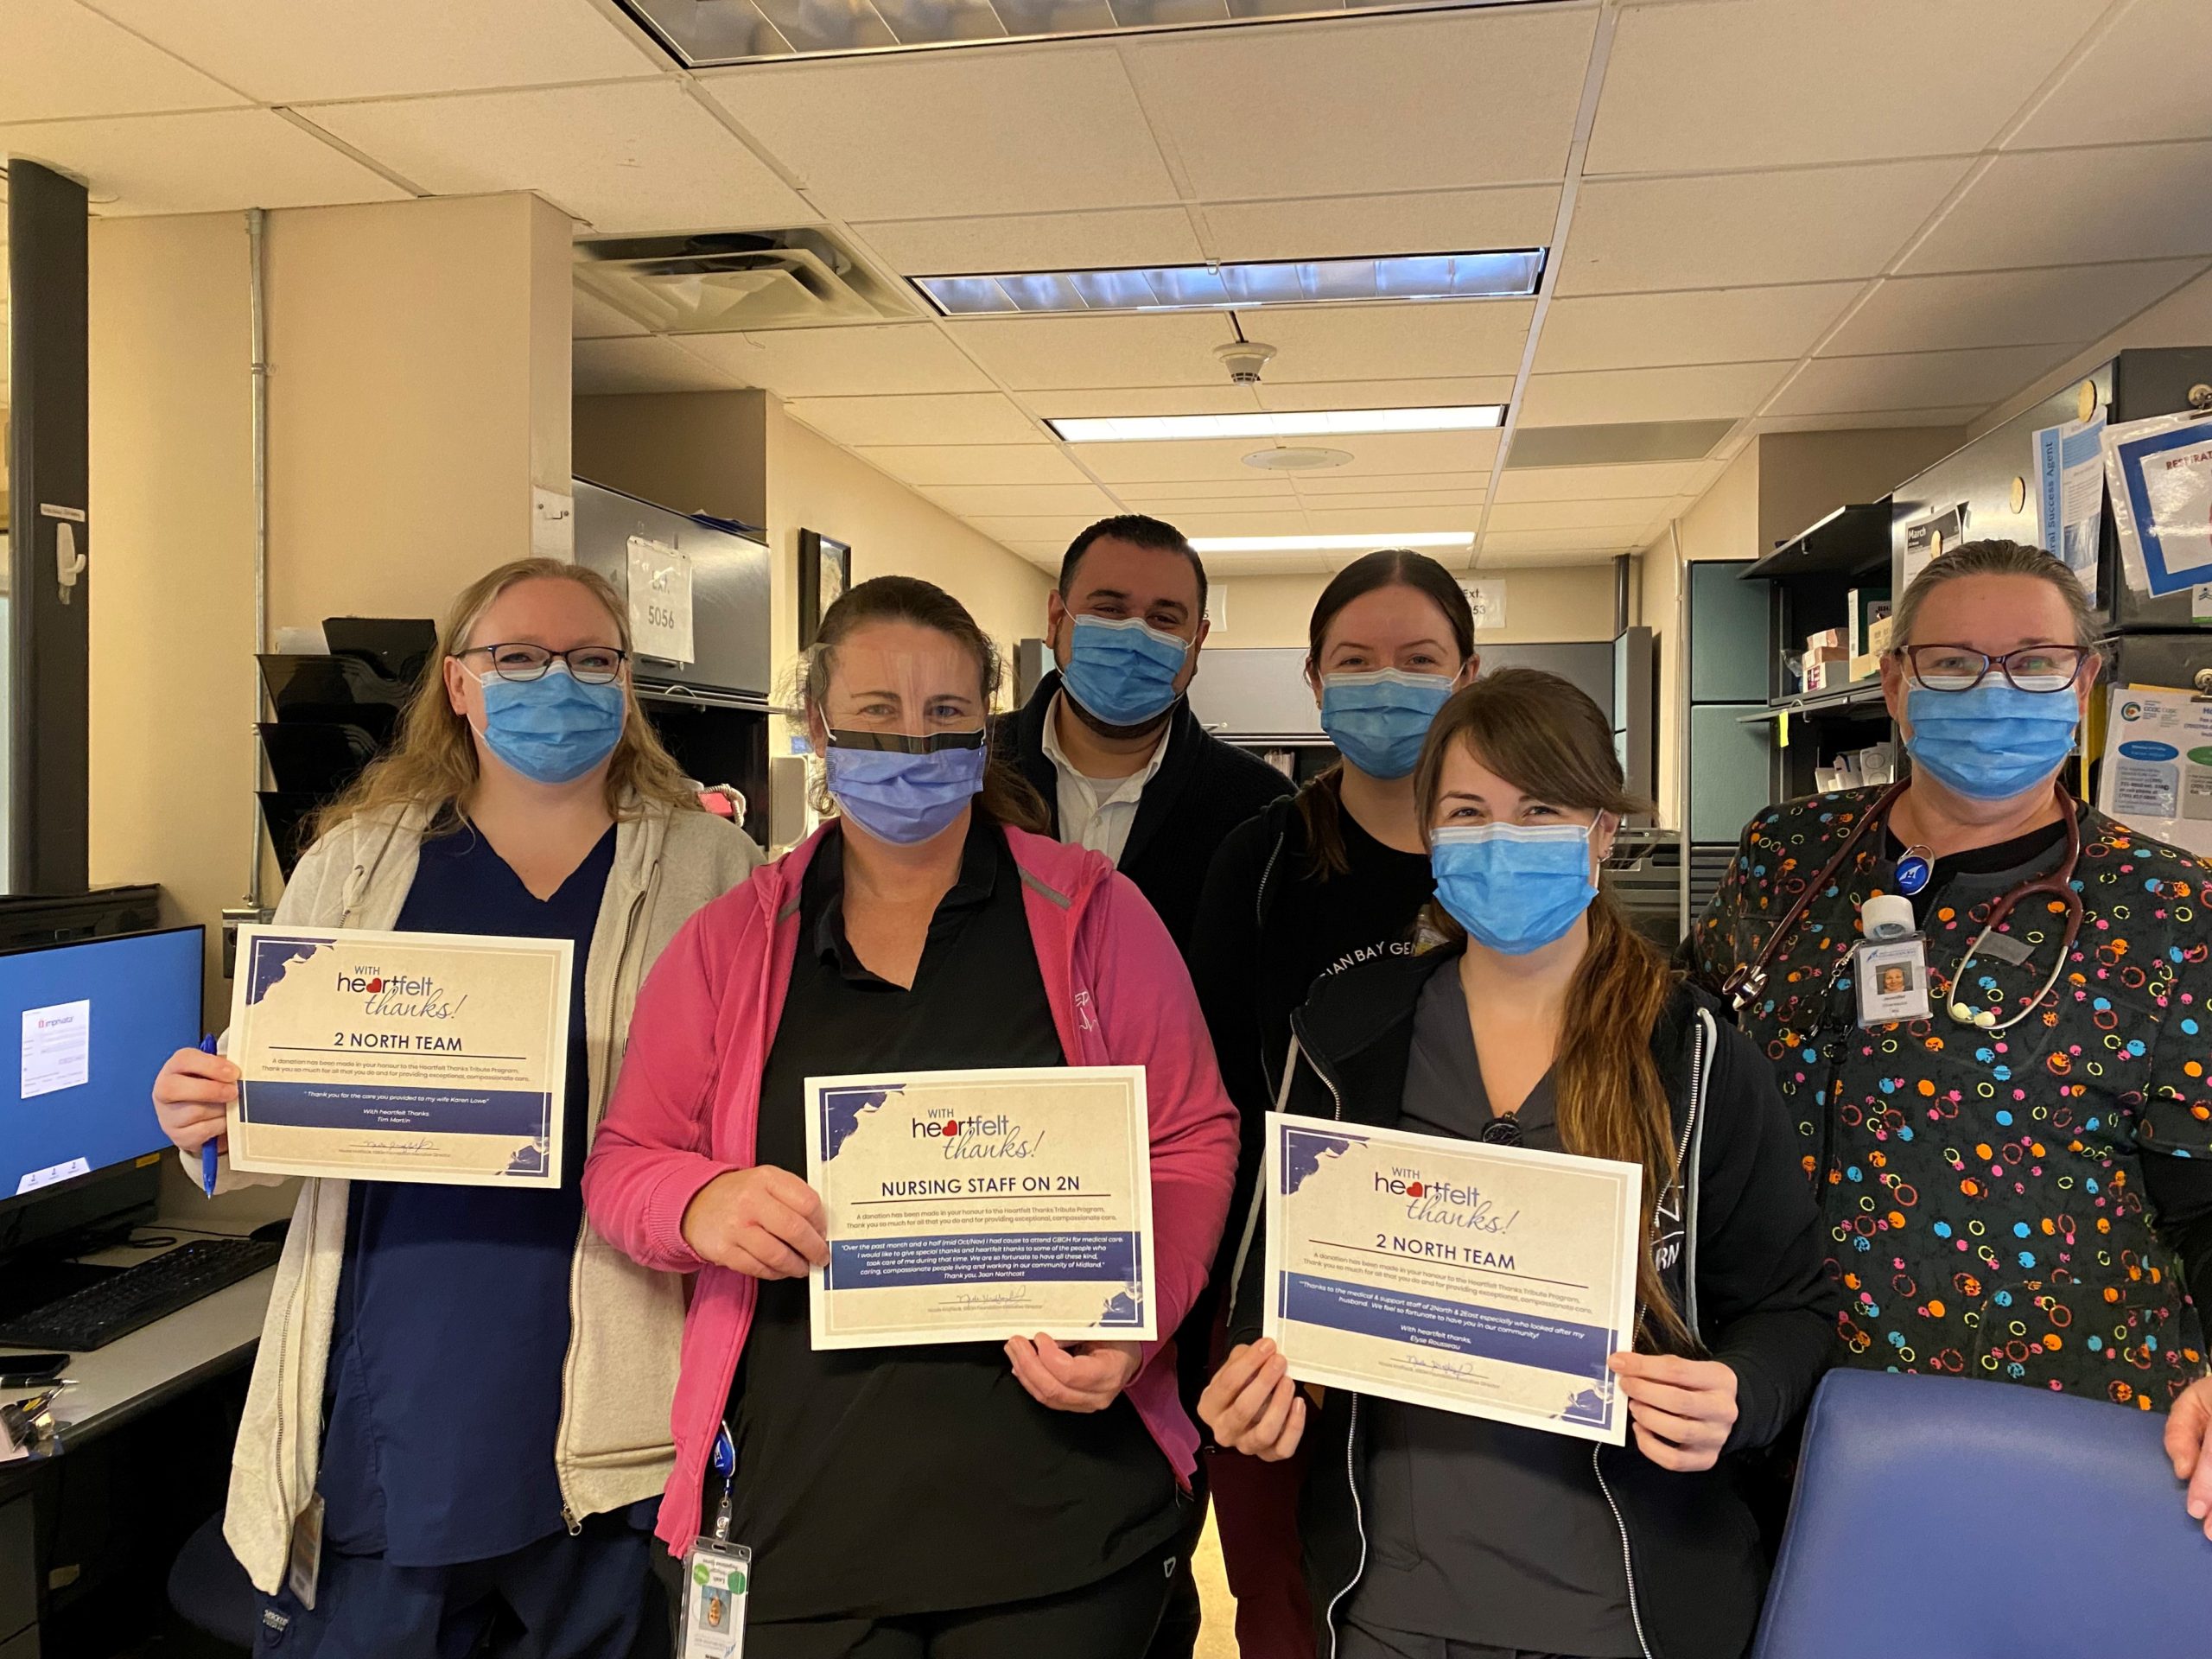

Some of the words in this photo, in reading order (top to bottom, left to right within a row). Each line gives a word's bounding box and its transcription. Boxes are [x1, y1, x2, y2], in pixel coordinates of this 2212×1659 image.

[2046, 442, 2056, 477] Agent
[2047, 481, 2056, 528] Success
[648, 605, 674, 629] 5056
[1354, 941, 1385, 962] BAY
[354, 965, 380, 975] WITH
[365, 988, 468, 1019] thanks!
[334, 1032, 344, 1046] 2
[350, 1033, 409, 1049] NORTH
[416, 1036, 462, 1051] TEAM
[928, 1109, 954, 1118] WITH
[942, 1126, 1045, 1160] thanks!
[1392, 1166, 1420, 1179] WITH
[882, 1179, 962, 1196] NURSING
[968, 1177, 1016, 1192] STAFF
[1022, 1176, 1050, 1192] ON
[1057, 1176, 1080, 1191] 2N
[1406, 1192, 1520, 1234] thanks!
[1376, 1233, 1386, 1248] 2
[1393, 1236, 1456, 1260] NORTH
[1463, 1248, 1515, 1270] TEAM
[1655, 1242, 1680, 1272] RN
[1346, 1290, 1373, 1299] medical
[1379, 1296, 1405, 1305] support
[1429, 1304, 1453, 1314] 2North
[1459, 1309, 1478, 1318] 2East
[1479, 1314, 1513, 1326] especially
[1529, 1322, 1554, 1332] looked
[1553, 1327, 1571, 1335] after
[1404, 1308, 1436, 1319] fortunate
[1445, 1315, 1462, 1324] have
[1400, 1324, 1416, 1332] With
[1417, 1327, 1445, 1338] heartfelt
[1409, 1334, 1427, 1343] Elyse
